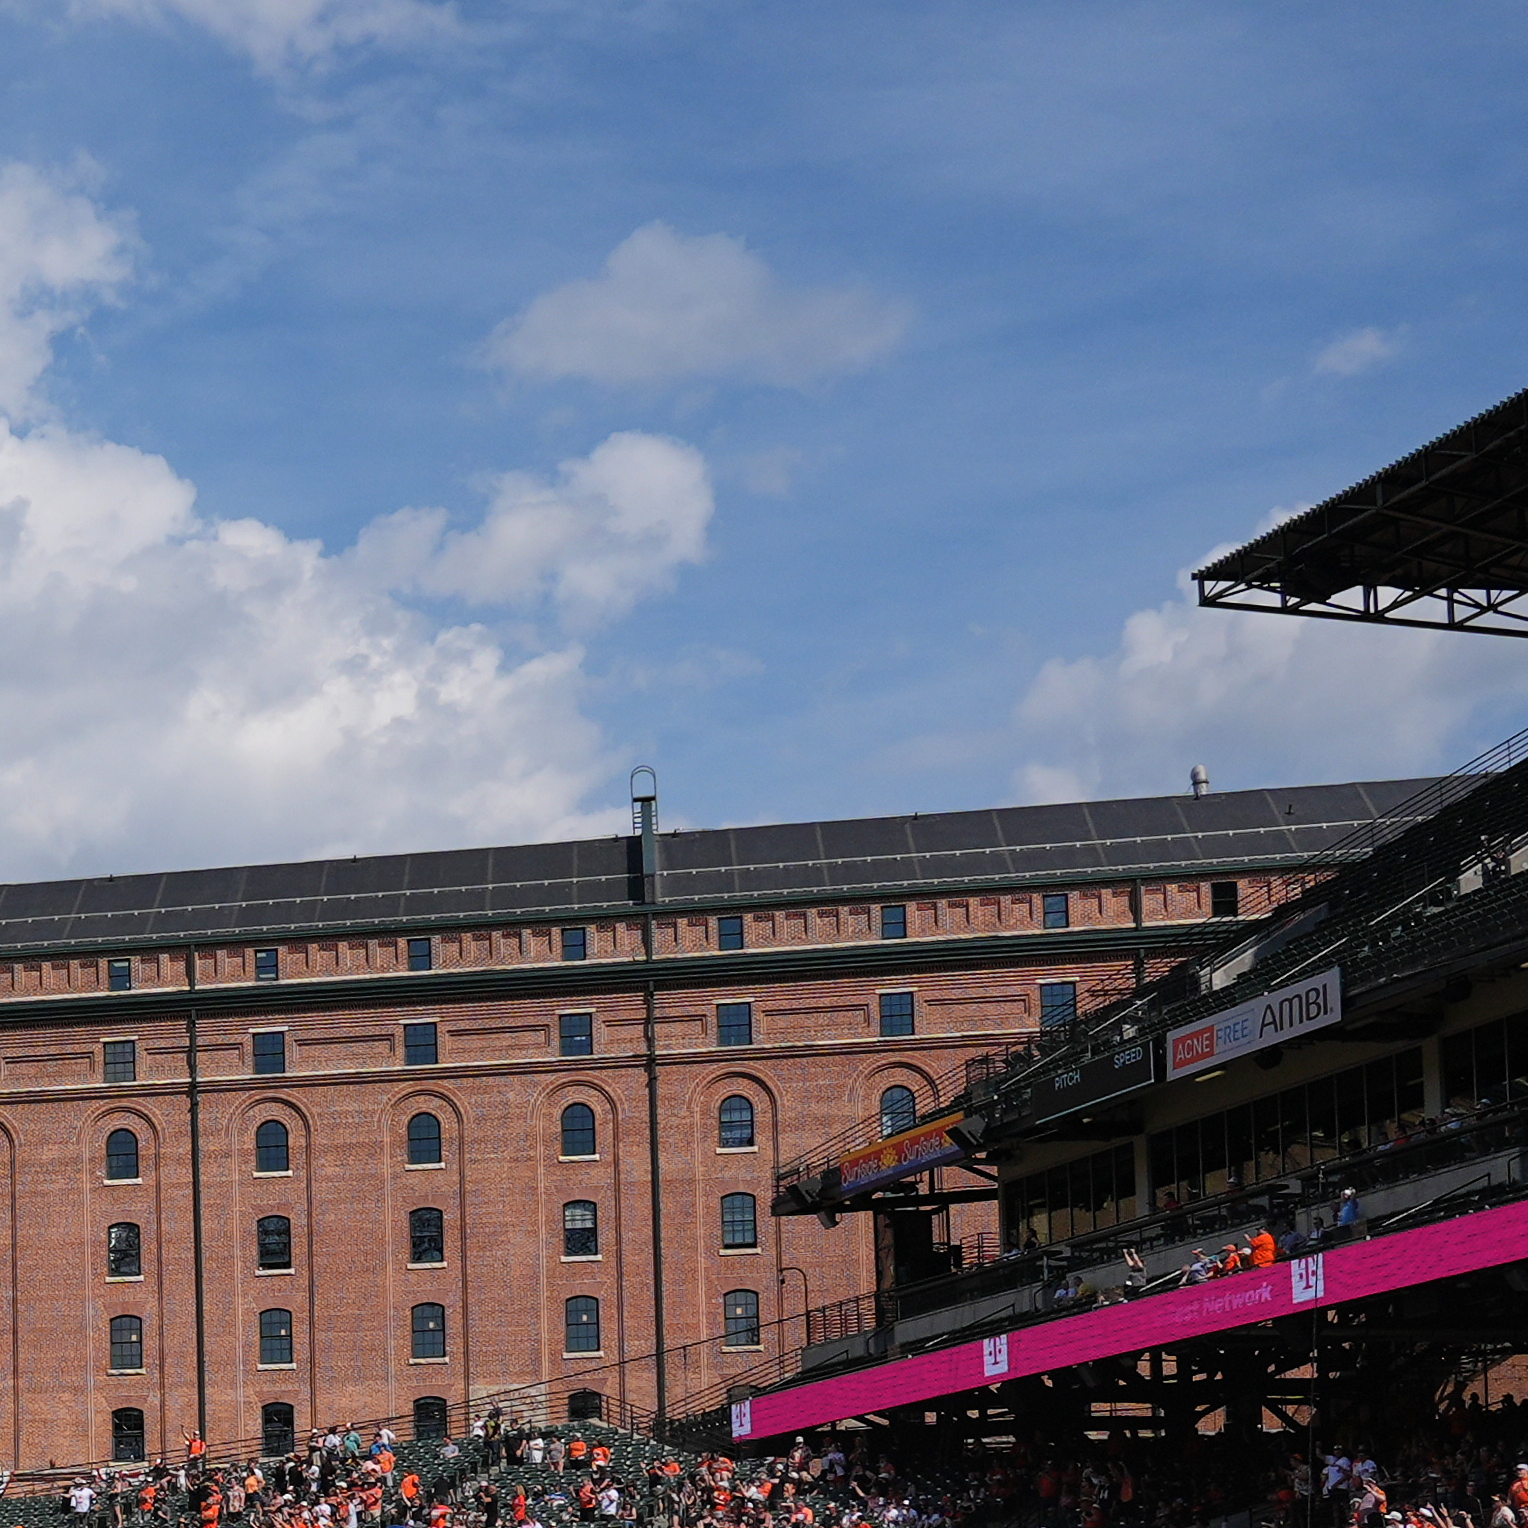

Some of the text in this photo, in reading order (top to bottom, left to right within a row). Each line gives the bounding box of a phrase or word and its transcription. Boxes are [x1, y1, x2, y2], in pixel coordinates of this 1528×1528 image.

[1259, 983, 1329, 1038] AMBI
[1175, 1032, 1211, 1062] ACNE
[1216, 1018, 1251, 1045] FREE
[1054, 1047, 1143, 1090] PITCH SPEED
[1203, 1282, 1273, 1316] Network
